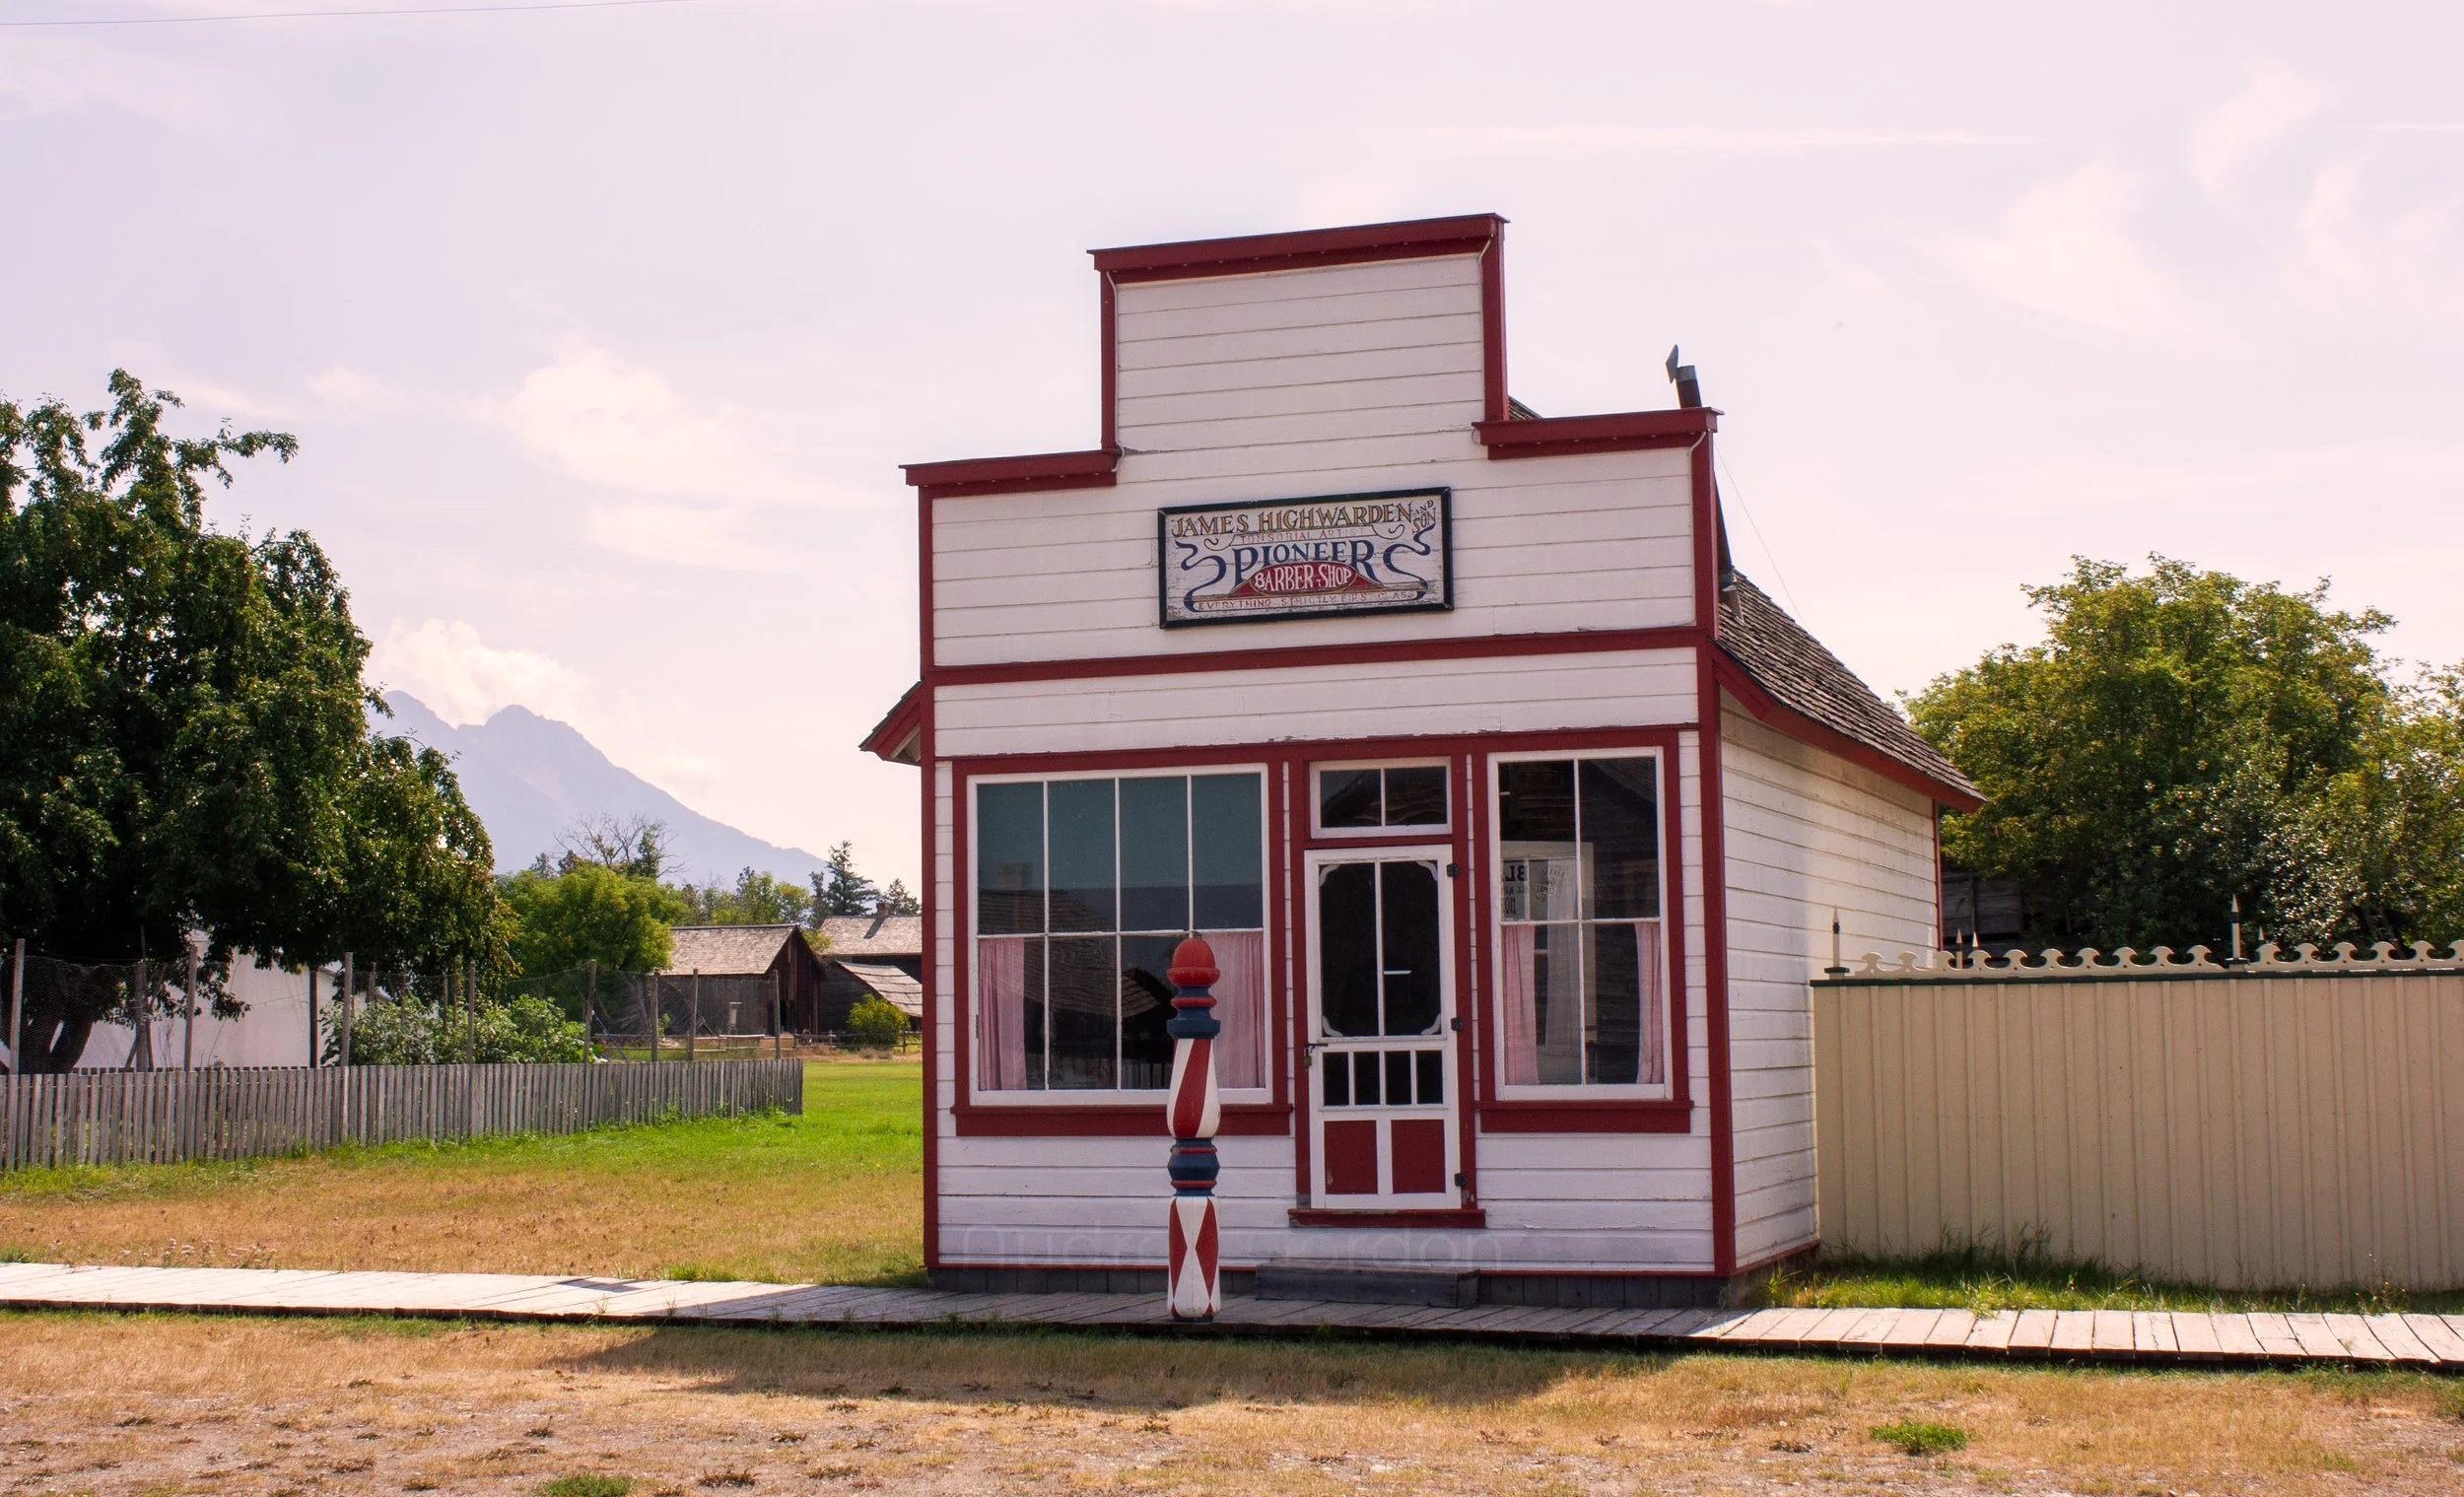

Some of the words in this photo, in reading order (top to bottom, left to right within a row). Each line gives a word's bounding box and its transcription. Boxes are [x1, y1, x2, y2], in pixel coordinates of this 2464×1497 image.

[1171, 511, 1250, 538] JAMES
[1258, 501, 1412, 533] HIGHWARDEN
[1411, 507, 1437, 535] SON
[1239, 531, 1312, 544] TONSORIAL
[1231, 539, 1382, 588] PIONEER
[1254, 564, 1315, 592] BARBER
[1316, 563, 1353, 589] SHOP
[1198, 597, 1272, 611] EVERYTHING
[1280, 593, 1337, 607] STRICTLY
[1339, 592, 1373, 604] FIRS
